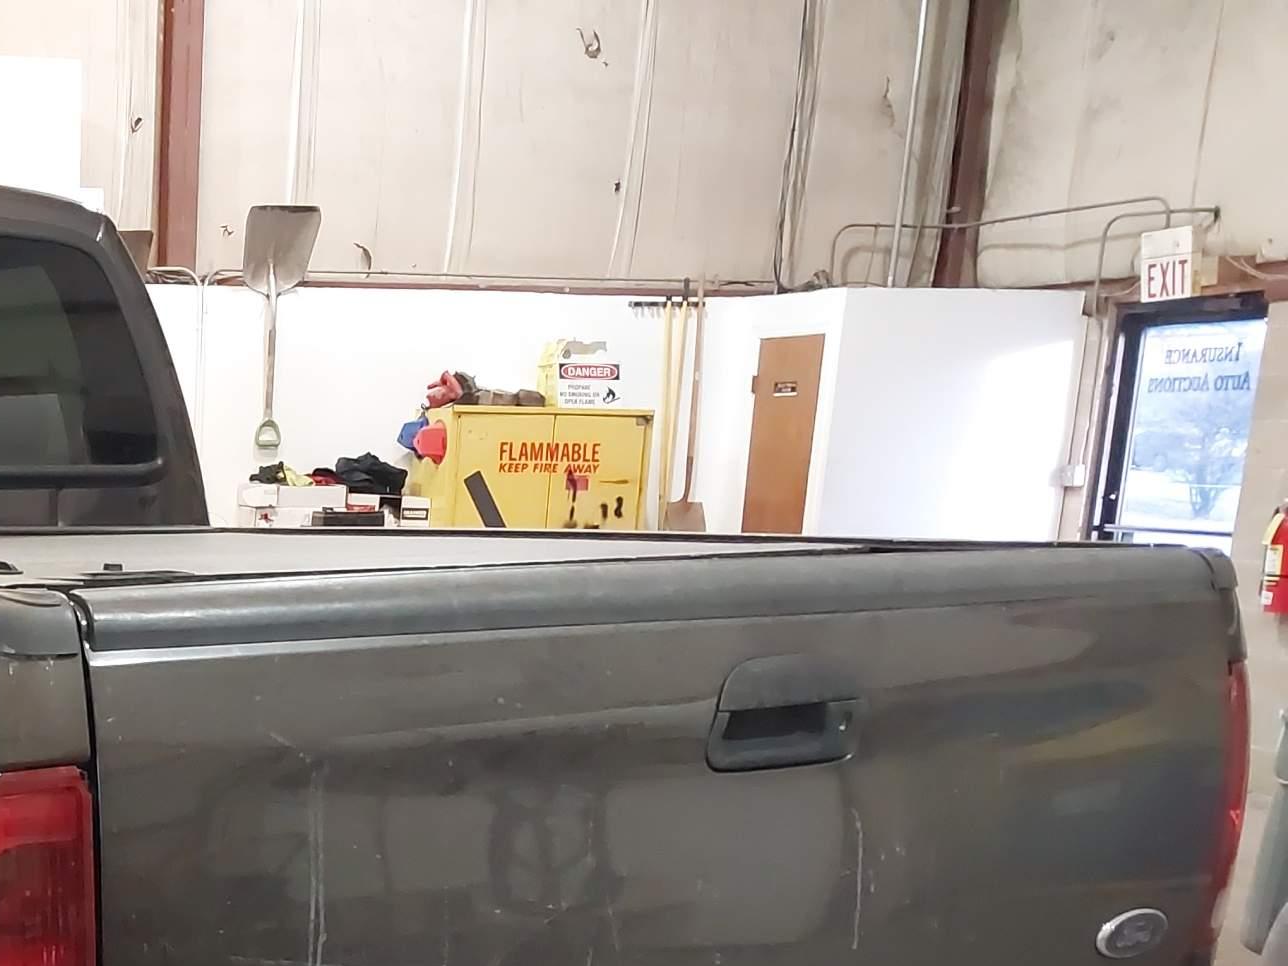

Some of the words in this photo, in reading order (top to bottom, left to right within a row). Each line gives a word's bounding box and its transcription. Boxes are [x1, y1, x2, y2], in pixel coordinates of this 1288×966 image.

[1148, 260, 1188, 298] EXIT
[567, 366, 611, 377] DANGER
[499, 441, 601, 462] FLAMMABLE
[499, 463, 529, 473] KEEP
[533, 463, 559, 474] FIRE
[563, 463, 600, 475] AWAY
